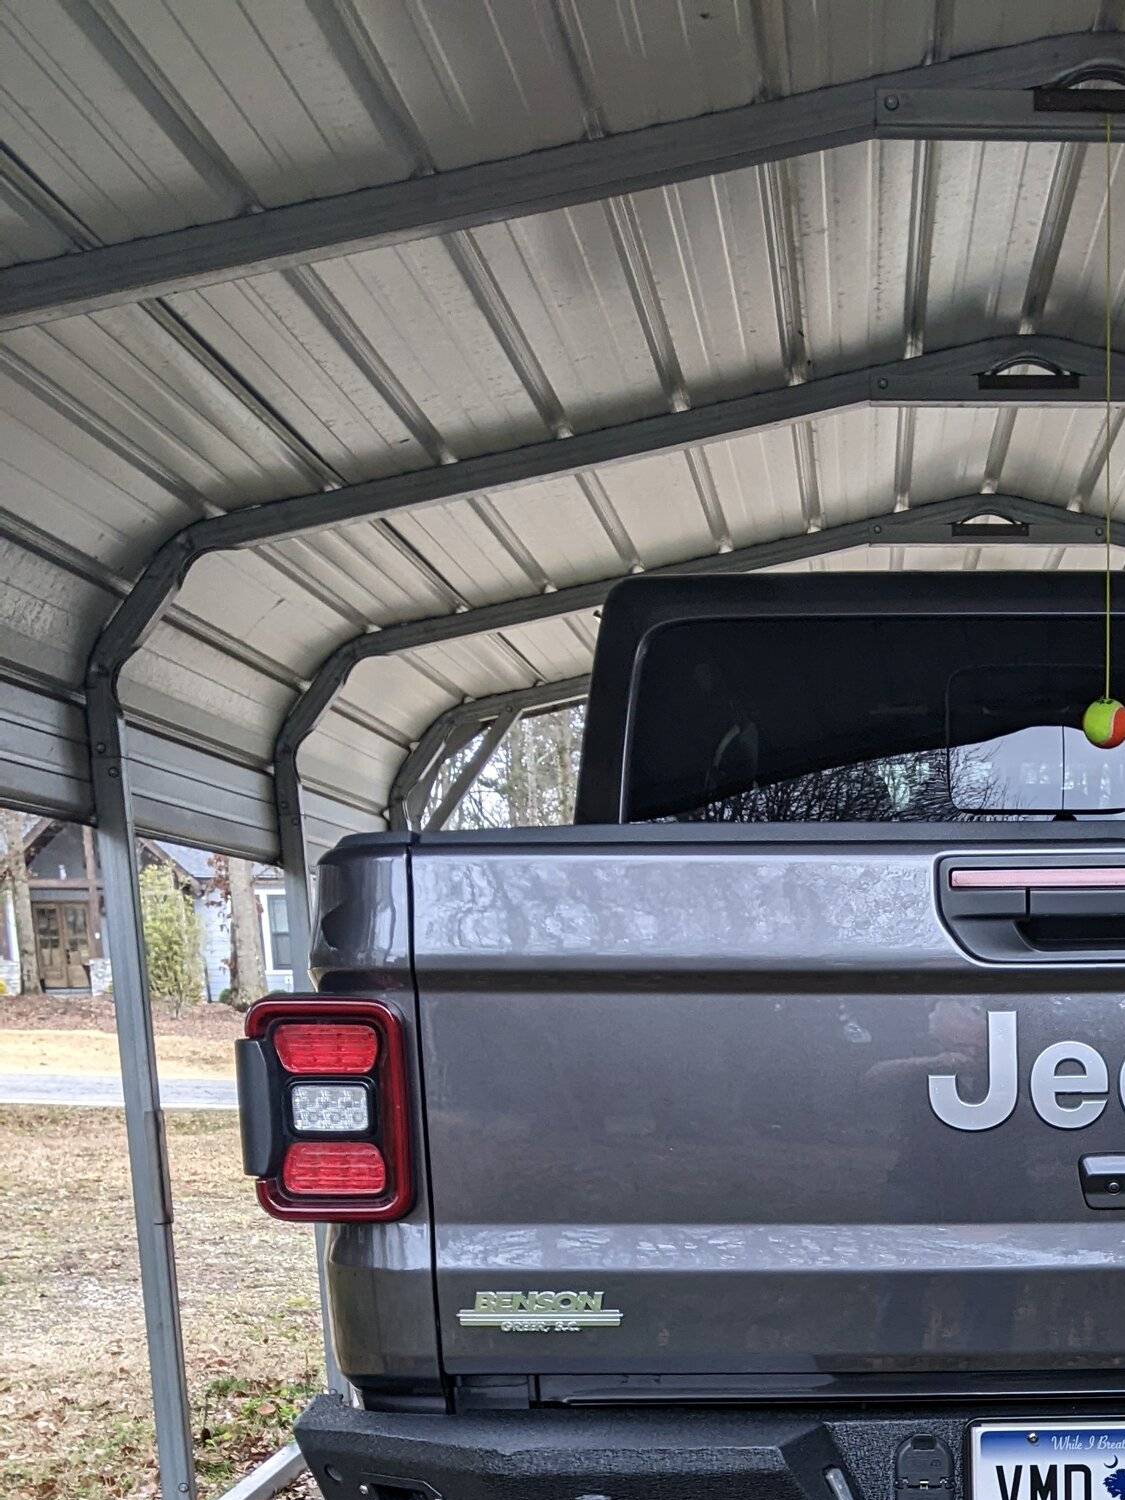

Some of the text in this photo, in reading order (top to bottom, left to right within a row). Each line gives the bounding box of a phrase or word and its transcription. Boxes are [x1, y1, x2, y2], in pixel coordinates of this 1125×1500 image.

[474, 1291, 605, 1313] BENSON
[1051, 1435, 1082, 1450] While
[1084, 1435, 1095, 1450] I
